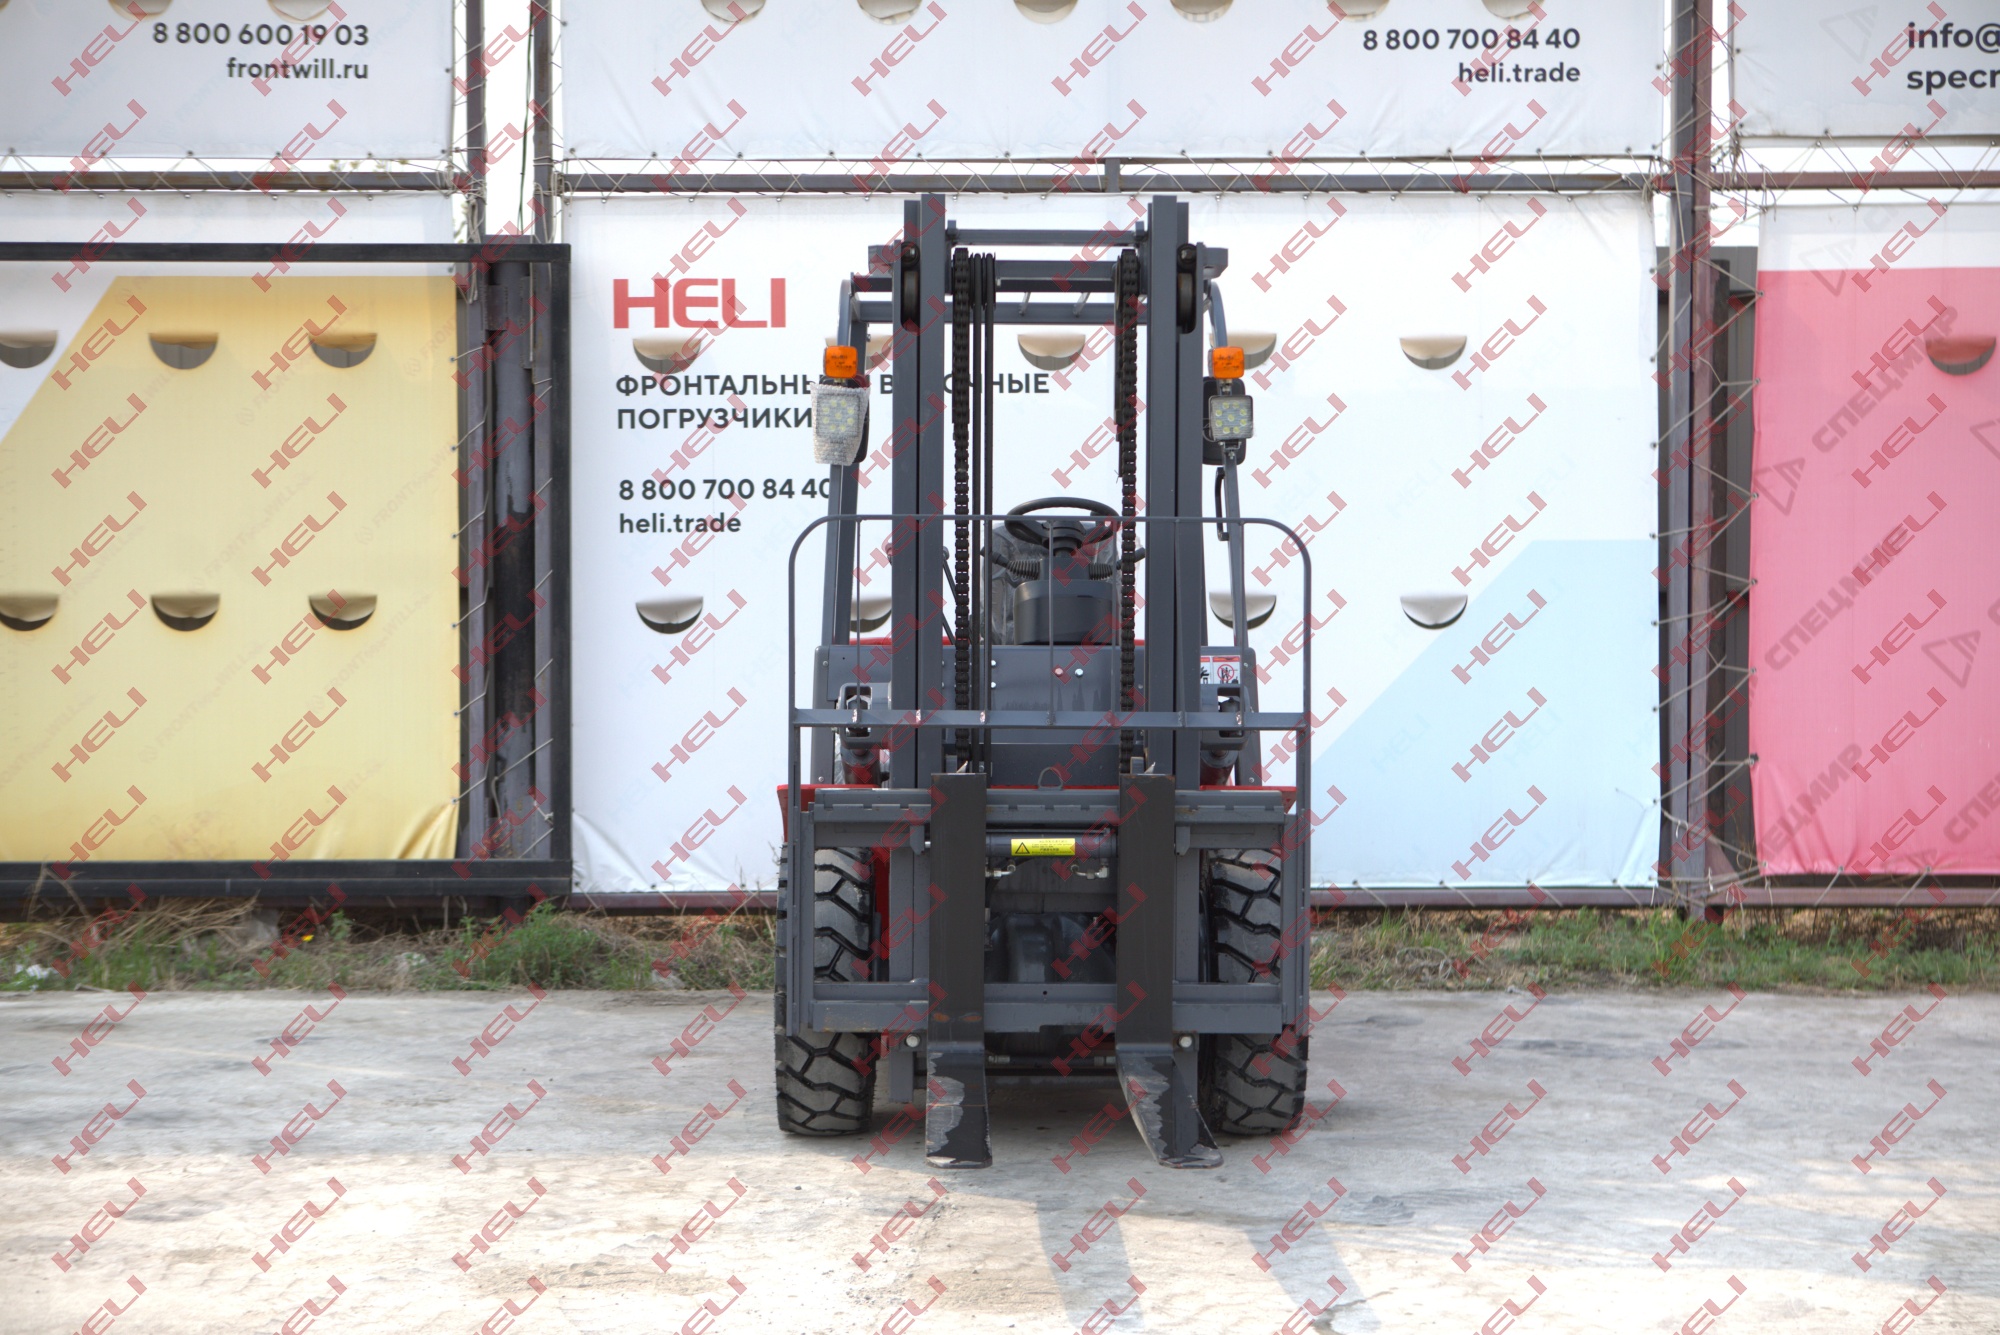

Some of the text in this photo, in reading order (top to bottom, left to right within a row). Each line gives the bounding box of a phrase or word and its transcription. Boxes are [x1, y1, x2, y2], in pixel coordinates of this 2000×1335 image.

[154, 23, 369, 46] 8 800 600 19 03
[1363, 28, 1580, 51] 8 800 700 84 40
[227, 57, 368, 79] frontwill.ru
[1459, 62, 1581, 83] heli.trade
[614, 278, 786, 328] HELI
[618, 408, 812, 430] ПОГРУЗЧИКИ
[619, 479, 634, 500] 8
[642, 479, 696, 500] 800
[703, 479, 755, 500] 700
[763, 478, 795, 499] 84
[620, 512, 741, 533] heli.trade
